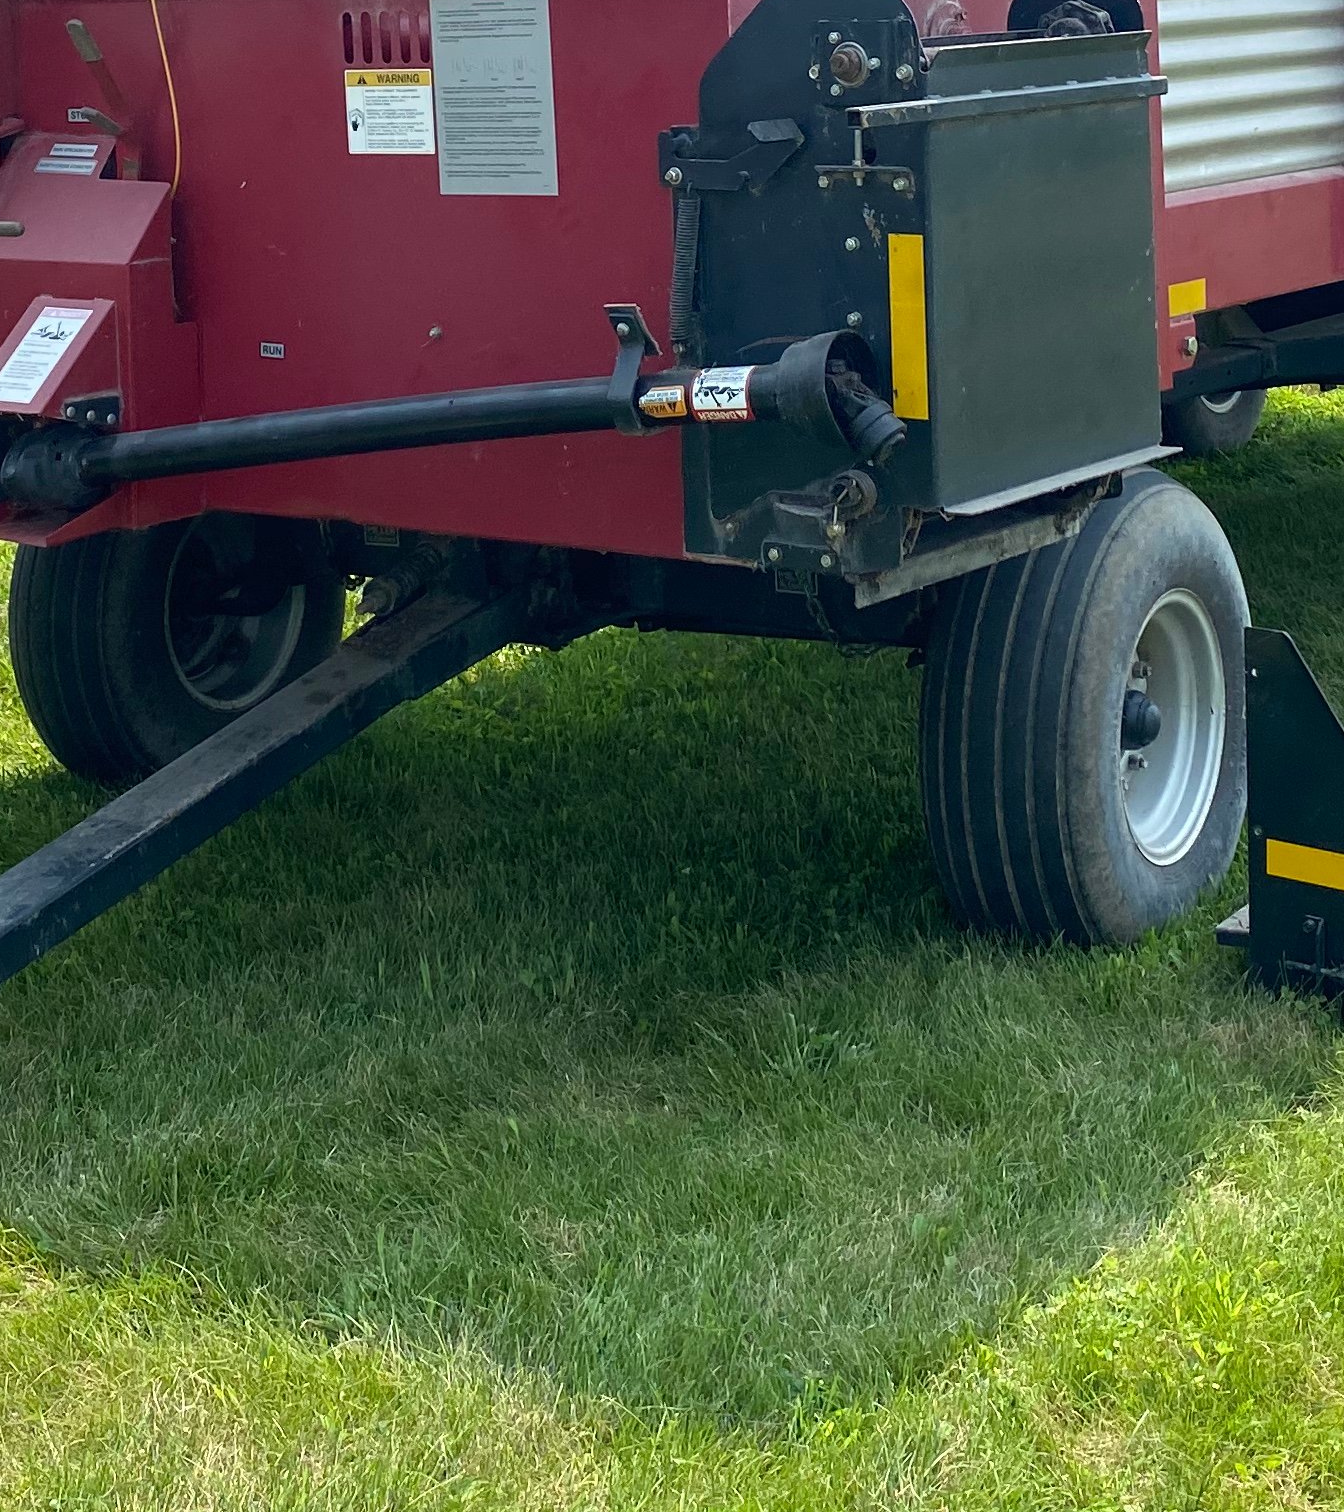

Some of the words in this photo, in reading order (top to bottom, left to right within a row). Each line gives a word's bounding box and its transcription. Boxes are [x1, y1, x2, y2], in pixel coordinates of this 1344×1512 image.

[376, 73, 420, 84] WARNING
[262, 344, 282, 356] RUN
[697, 410, 738, 420] DANGER
